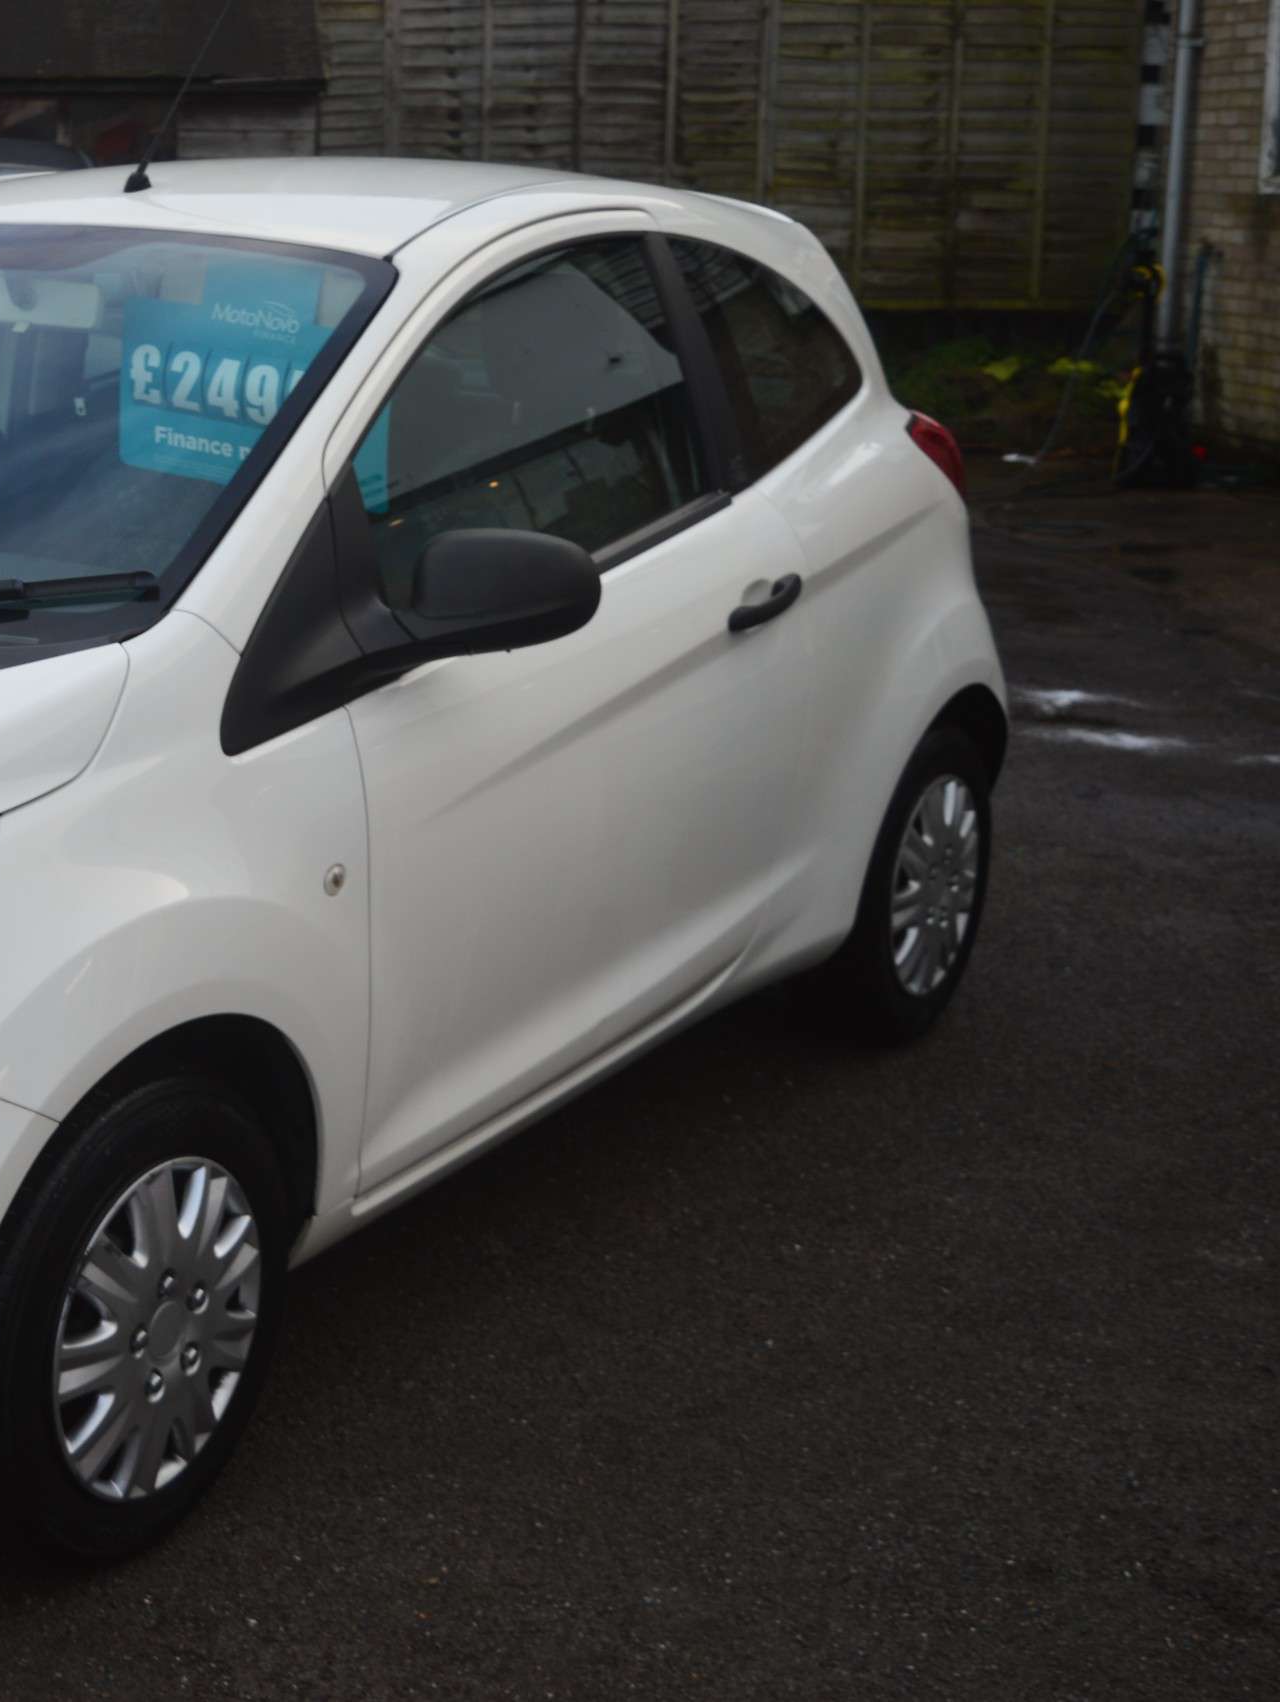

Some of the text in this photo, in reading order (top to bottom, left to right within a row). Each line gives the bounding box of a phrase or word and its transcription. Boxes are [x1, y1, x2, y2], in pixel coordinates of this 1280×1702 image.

[211, 302, 300, 334] MotoNovo
[130, 344, 306, 427] £249
[153, 425, 233, 457] Finance
